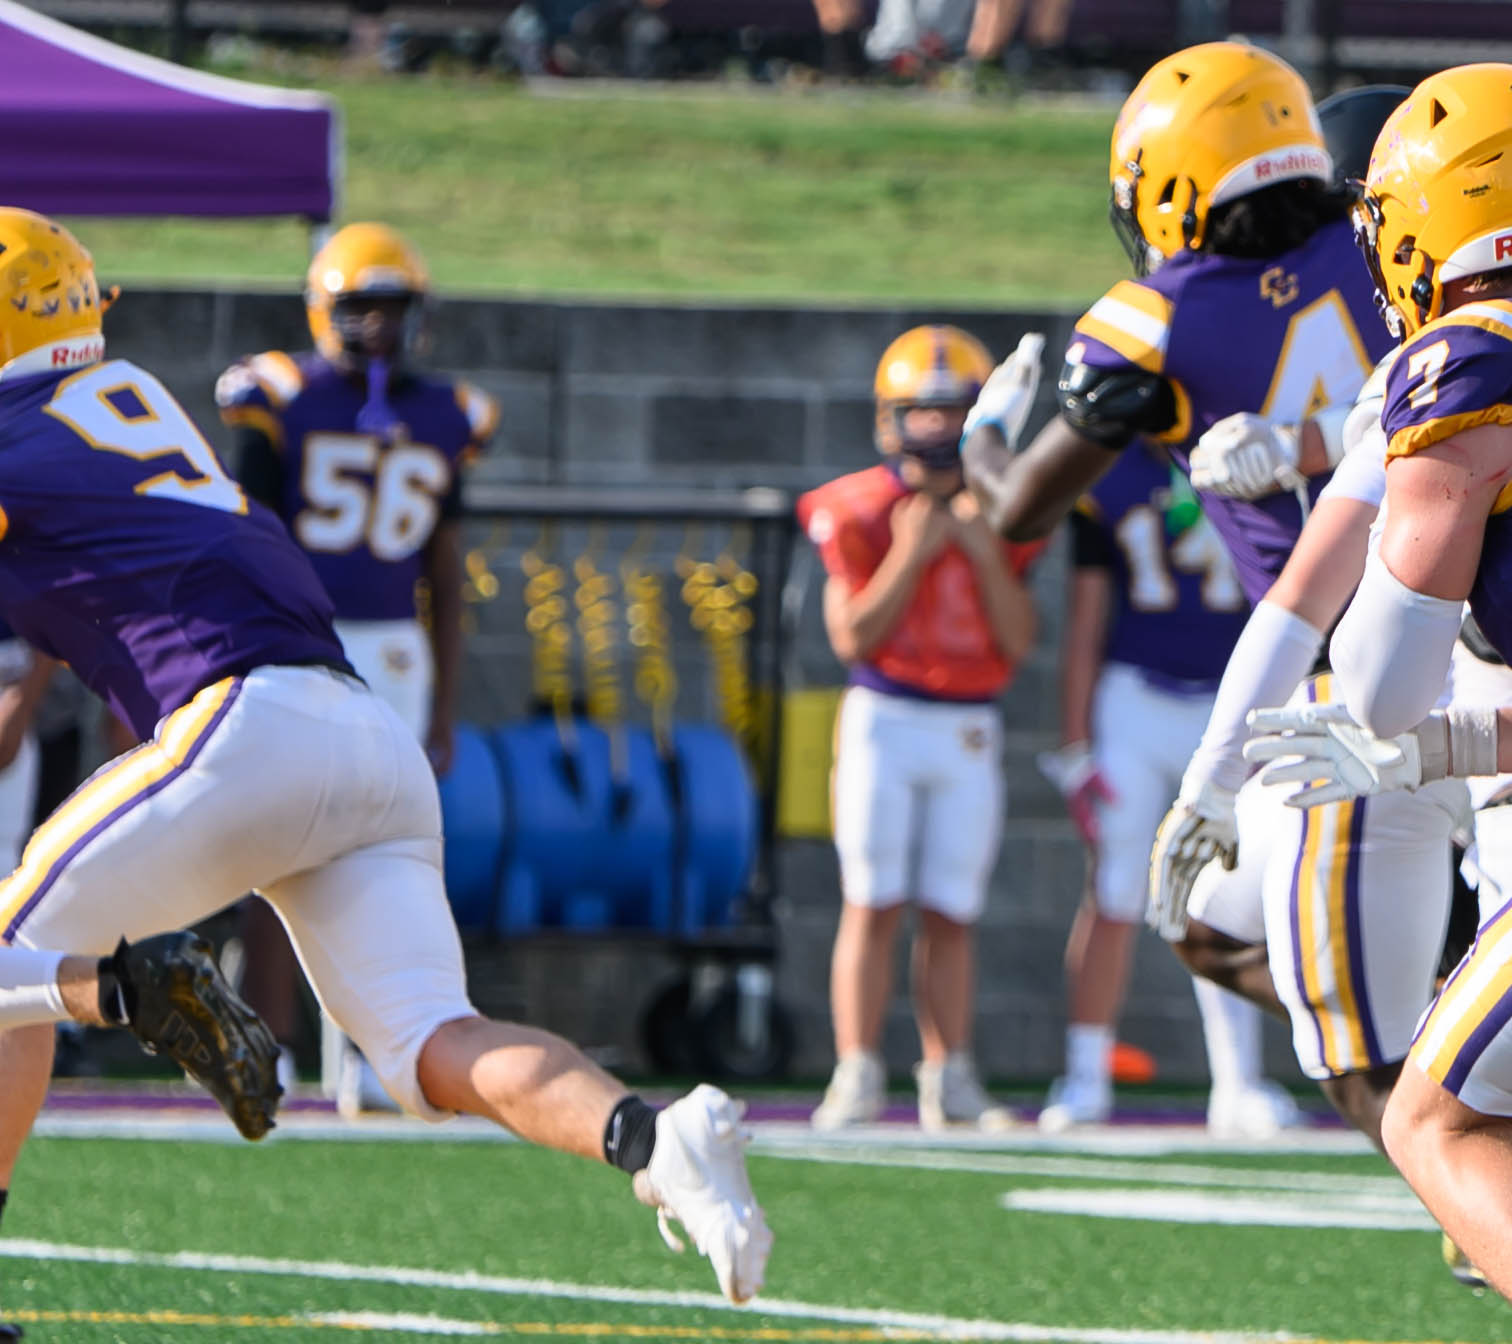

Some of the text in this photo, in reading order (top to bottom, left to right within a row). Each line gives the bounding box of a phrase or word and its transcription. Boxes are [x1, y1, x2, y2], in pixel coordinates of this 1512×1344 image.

[1407, 339, 1450, 410] 7
[41, 358, 250, 516] 9
[295, 431, 451, 561] 56
[1115, 503, 1243, 612] 14
